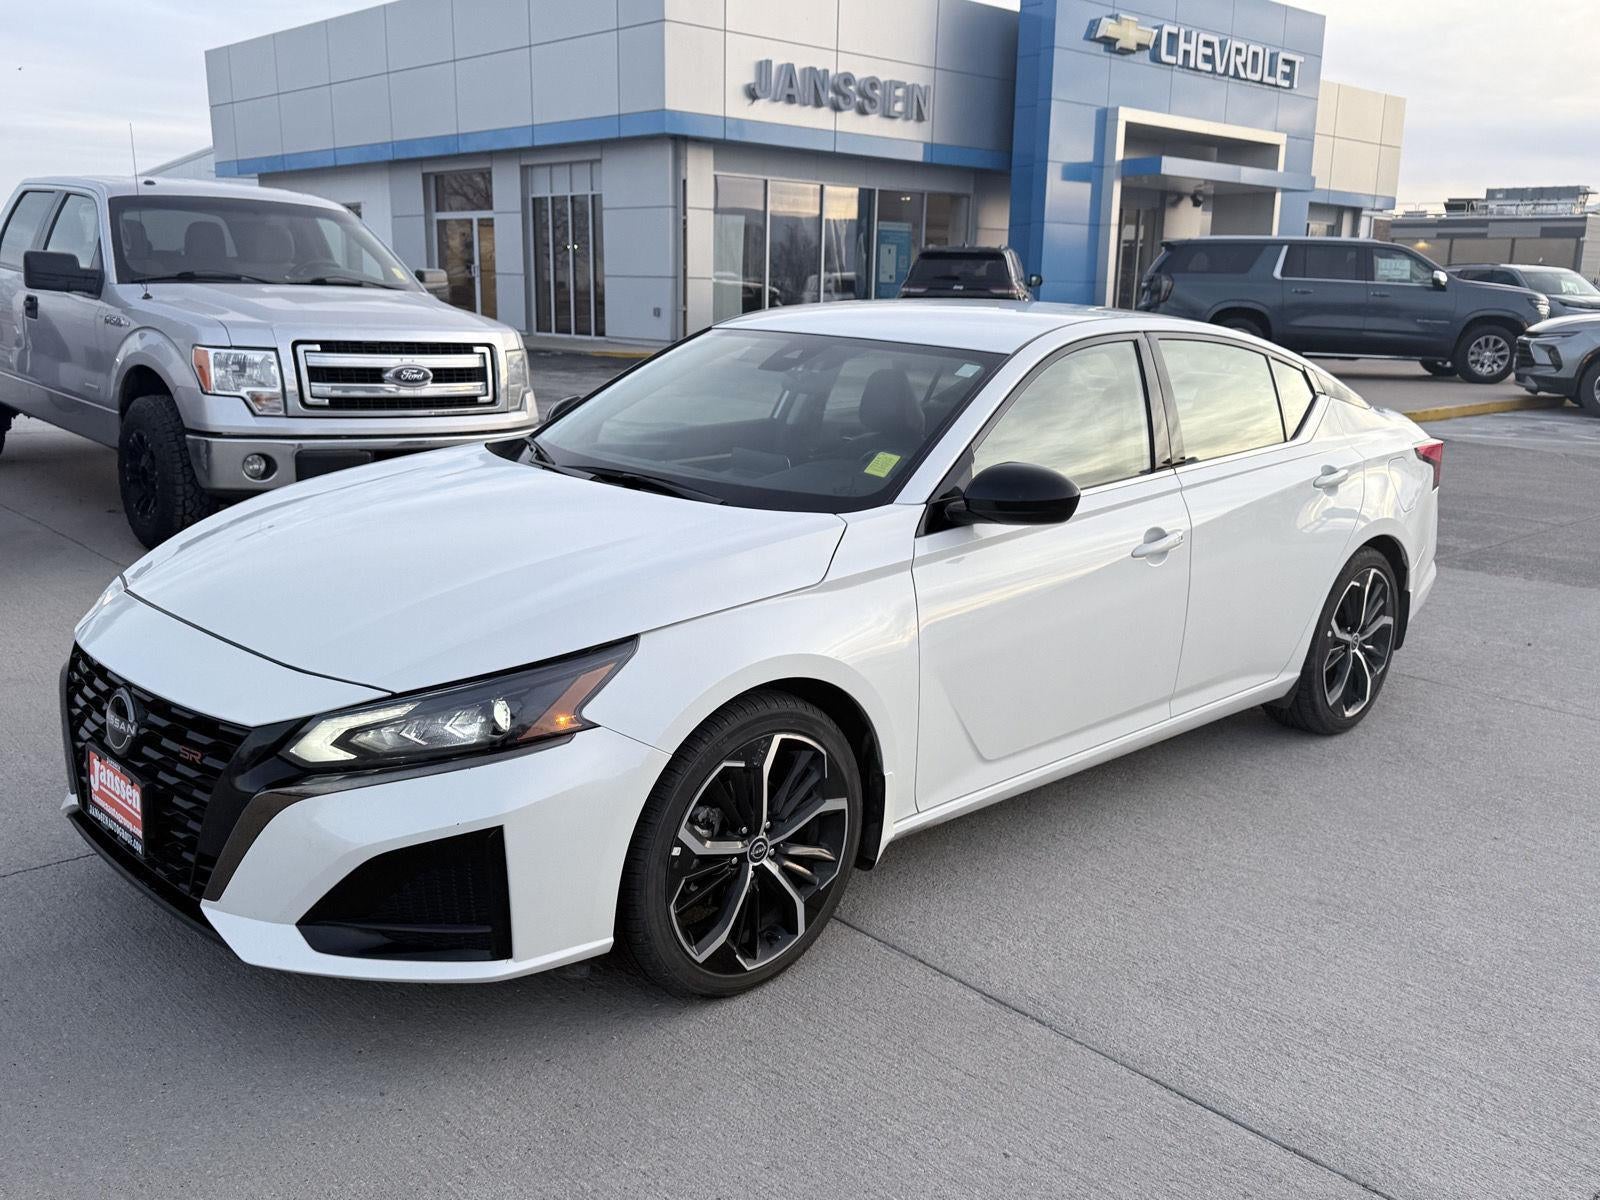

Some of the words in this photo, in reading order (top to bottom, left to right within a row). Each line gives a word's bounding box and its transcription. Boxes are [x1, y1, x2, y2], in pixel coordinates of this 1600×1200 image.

[1159, 24, 1304, 89] CHEVROLET
[745, 59, 931, 122] JANSSEN
[401, 369, 424, 380] Ford
[108, 713, 136, 735] SSAN
[179, 745, 201, 765] SR
[90, 757, 141, 814] Janssen
